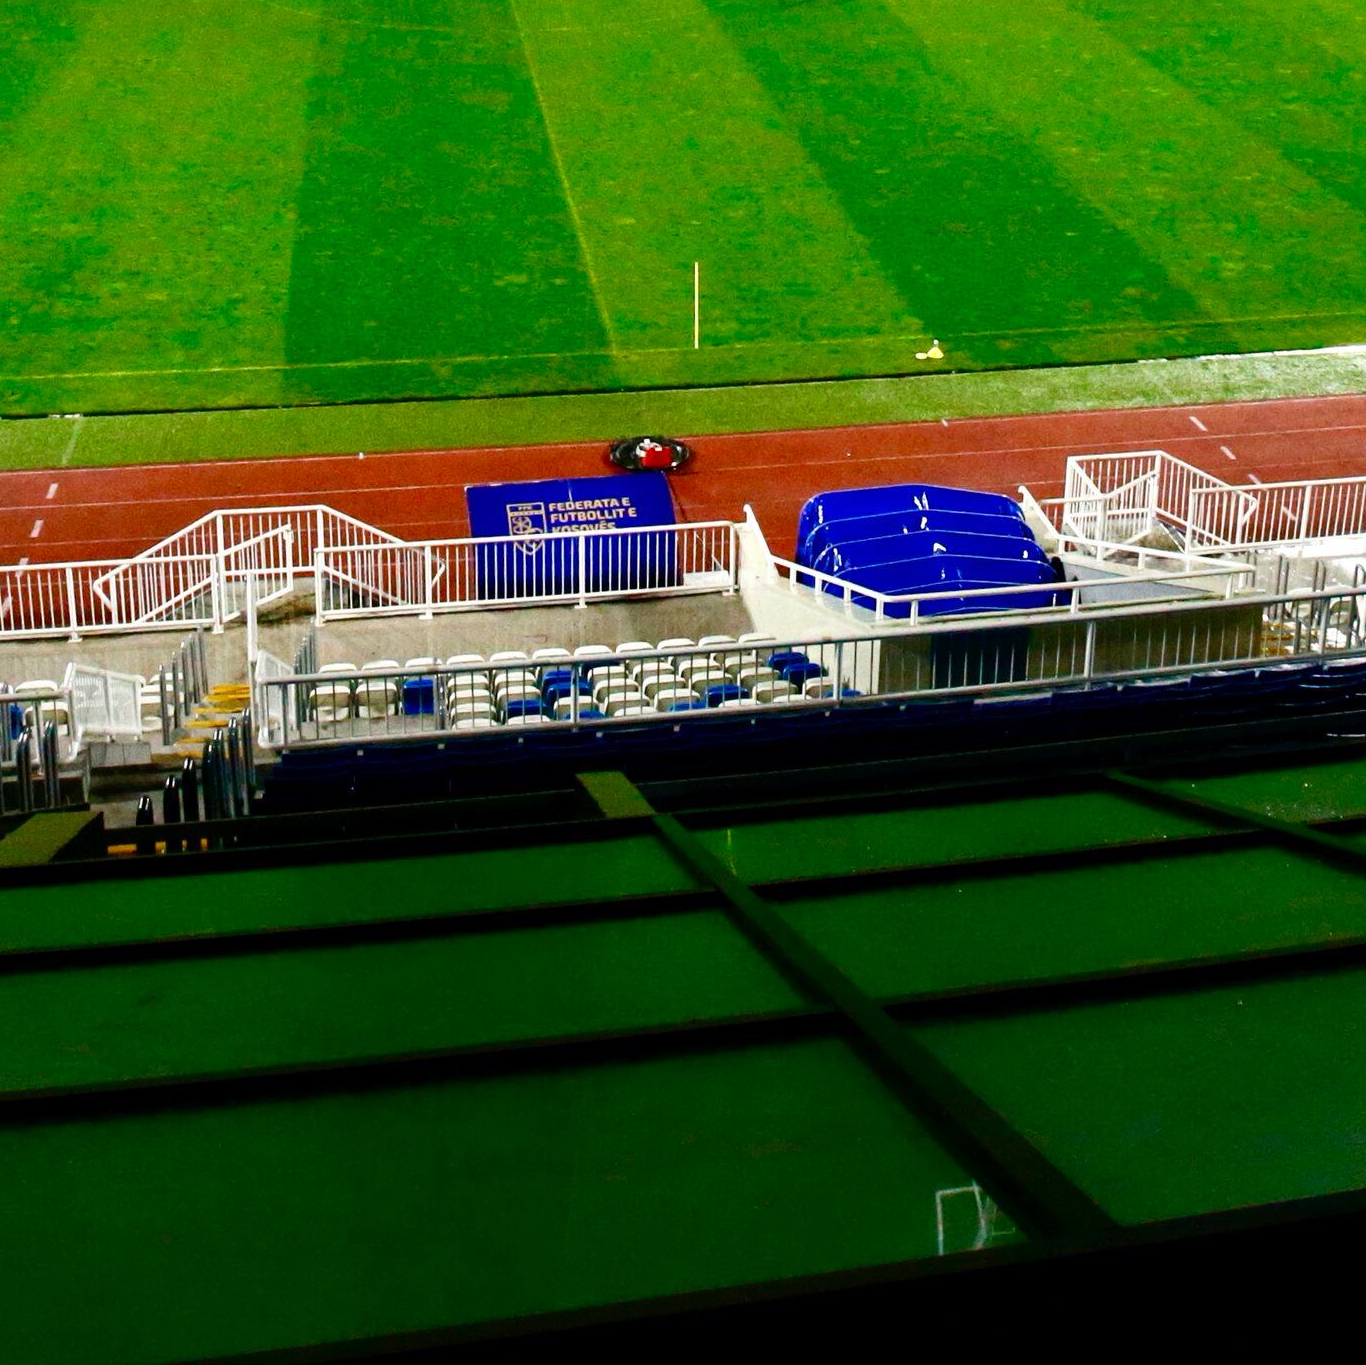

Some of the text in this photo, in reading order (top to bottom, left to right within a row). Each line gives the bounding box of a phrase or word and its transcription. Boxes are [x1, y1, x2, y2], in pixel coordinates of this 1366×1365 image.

[549, 497, 631, 512] FEDERATA E
[551, 507, 637, 523] FUTBOLLIT E
